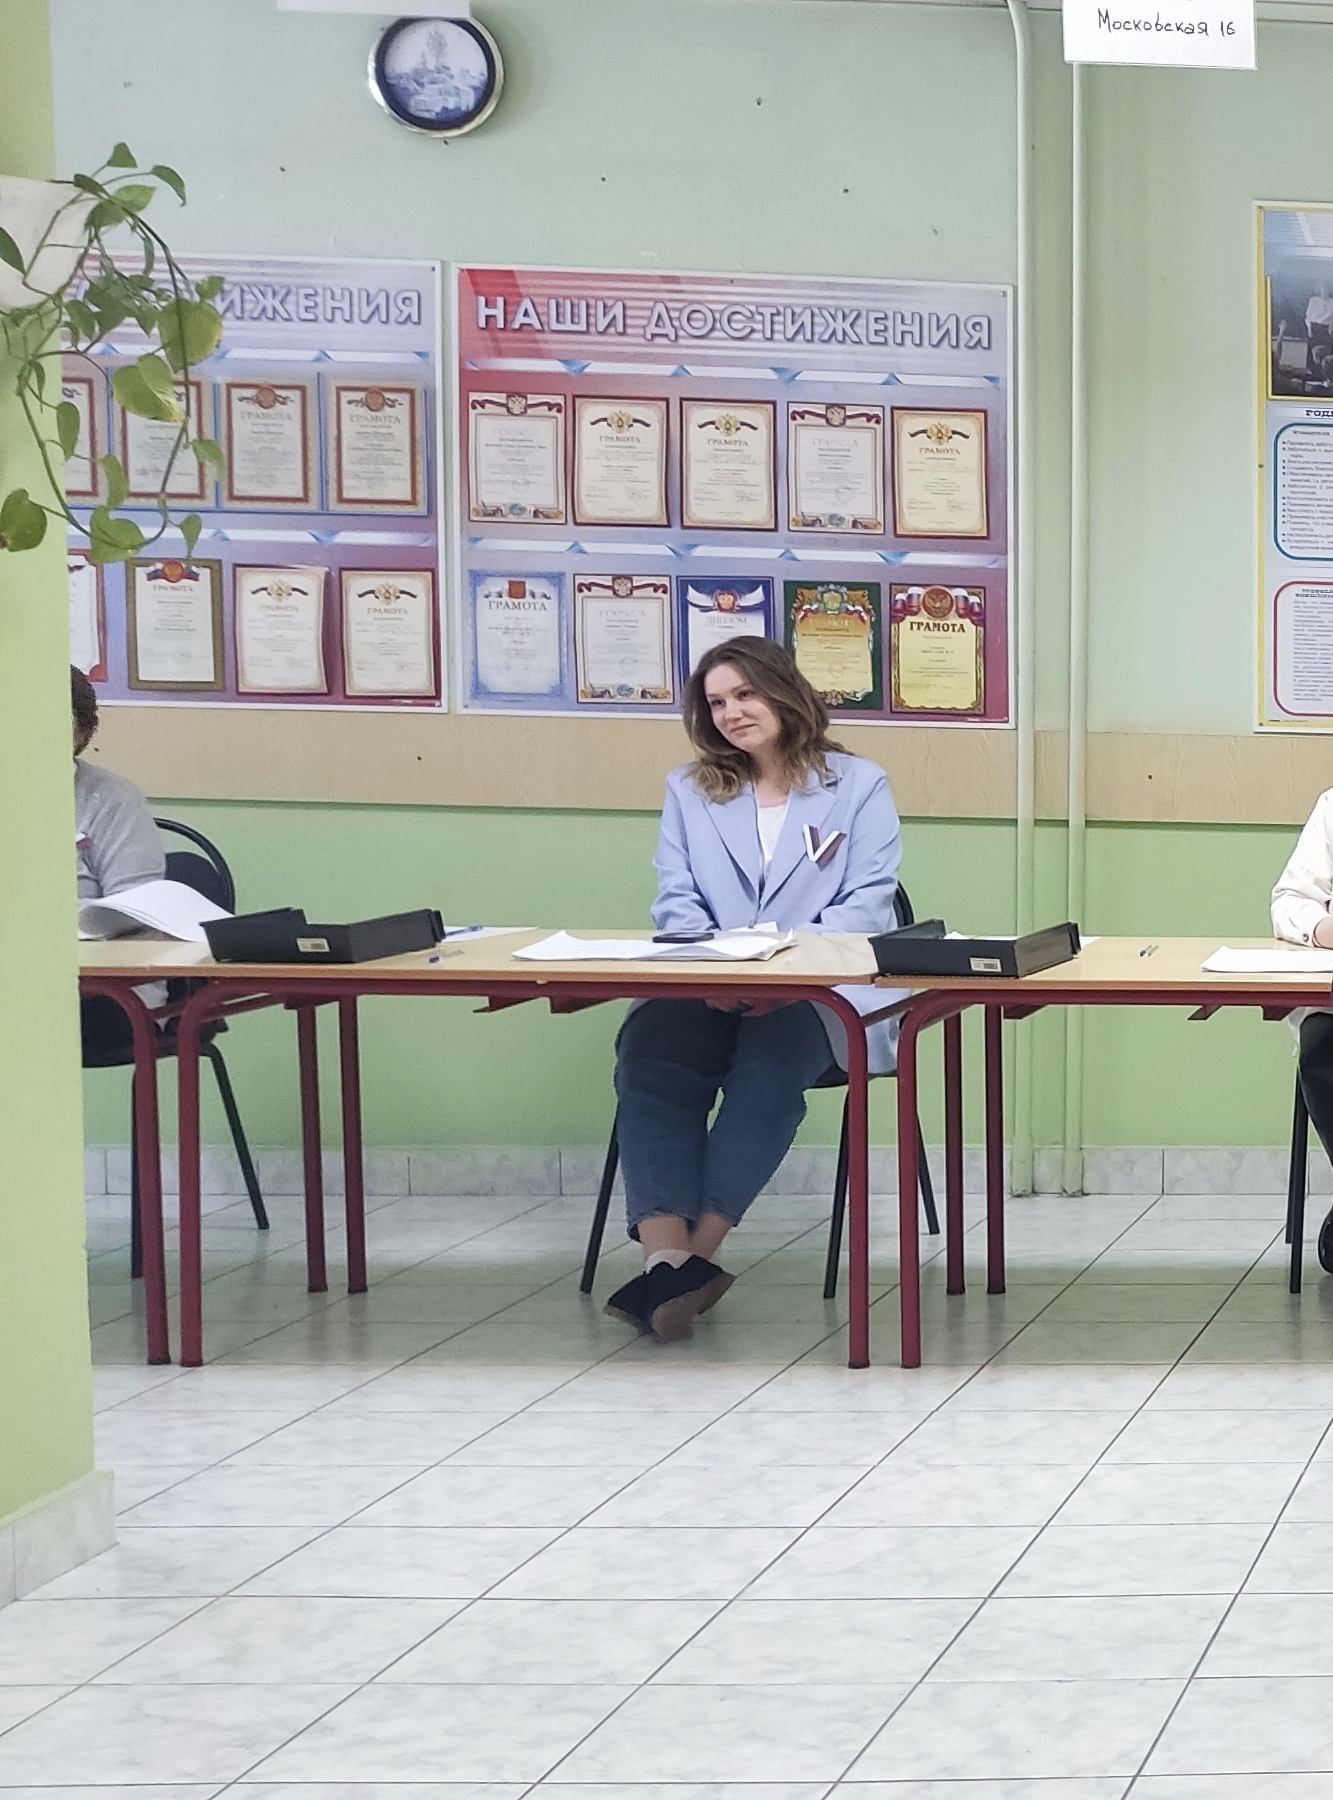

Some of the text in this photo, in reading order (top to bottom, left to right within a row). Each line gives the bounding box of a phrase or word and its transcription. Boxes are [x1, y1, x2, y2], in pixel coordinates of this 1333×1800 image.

[1097, 7, 1210, 36] Московская
[477, 296, 992, 350] НАШИ ДОСТИЖЕНИЯ
[488, 600, 548, 612] ГРАМОТА
[909, 620, 967, 635] ГРАМОТА
